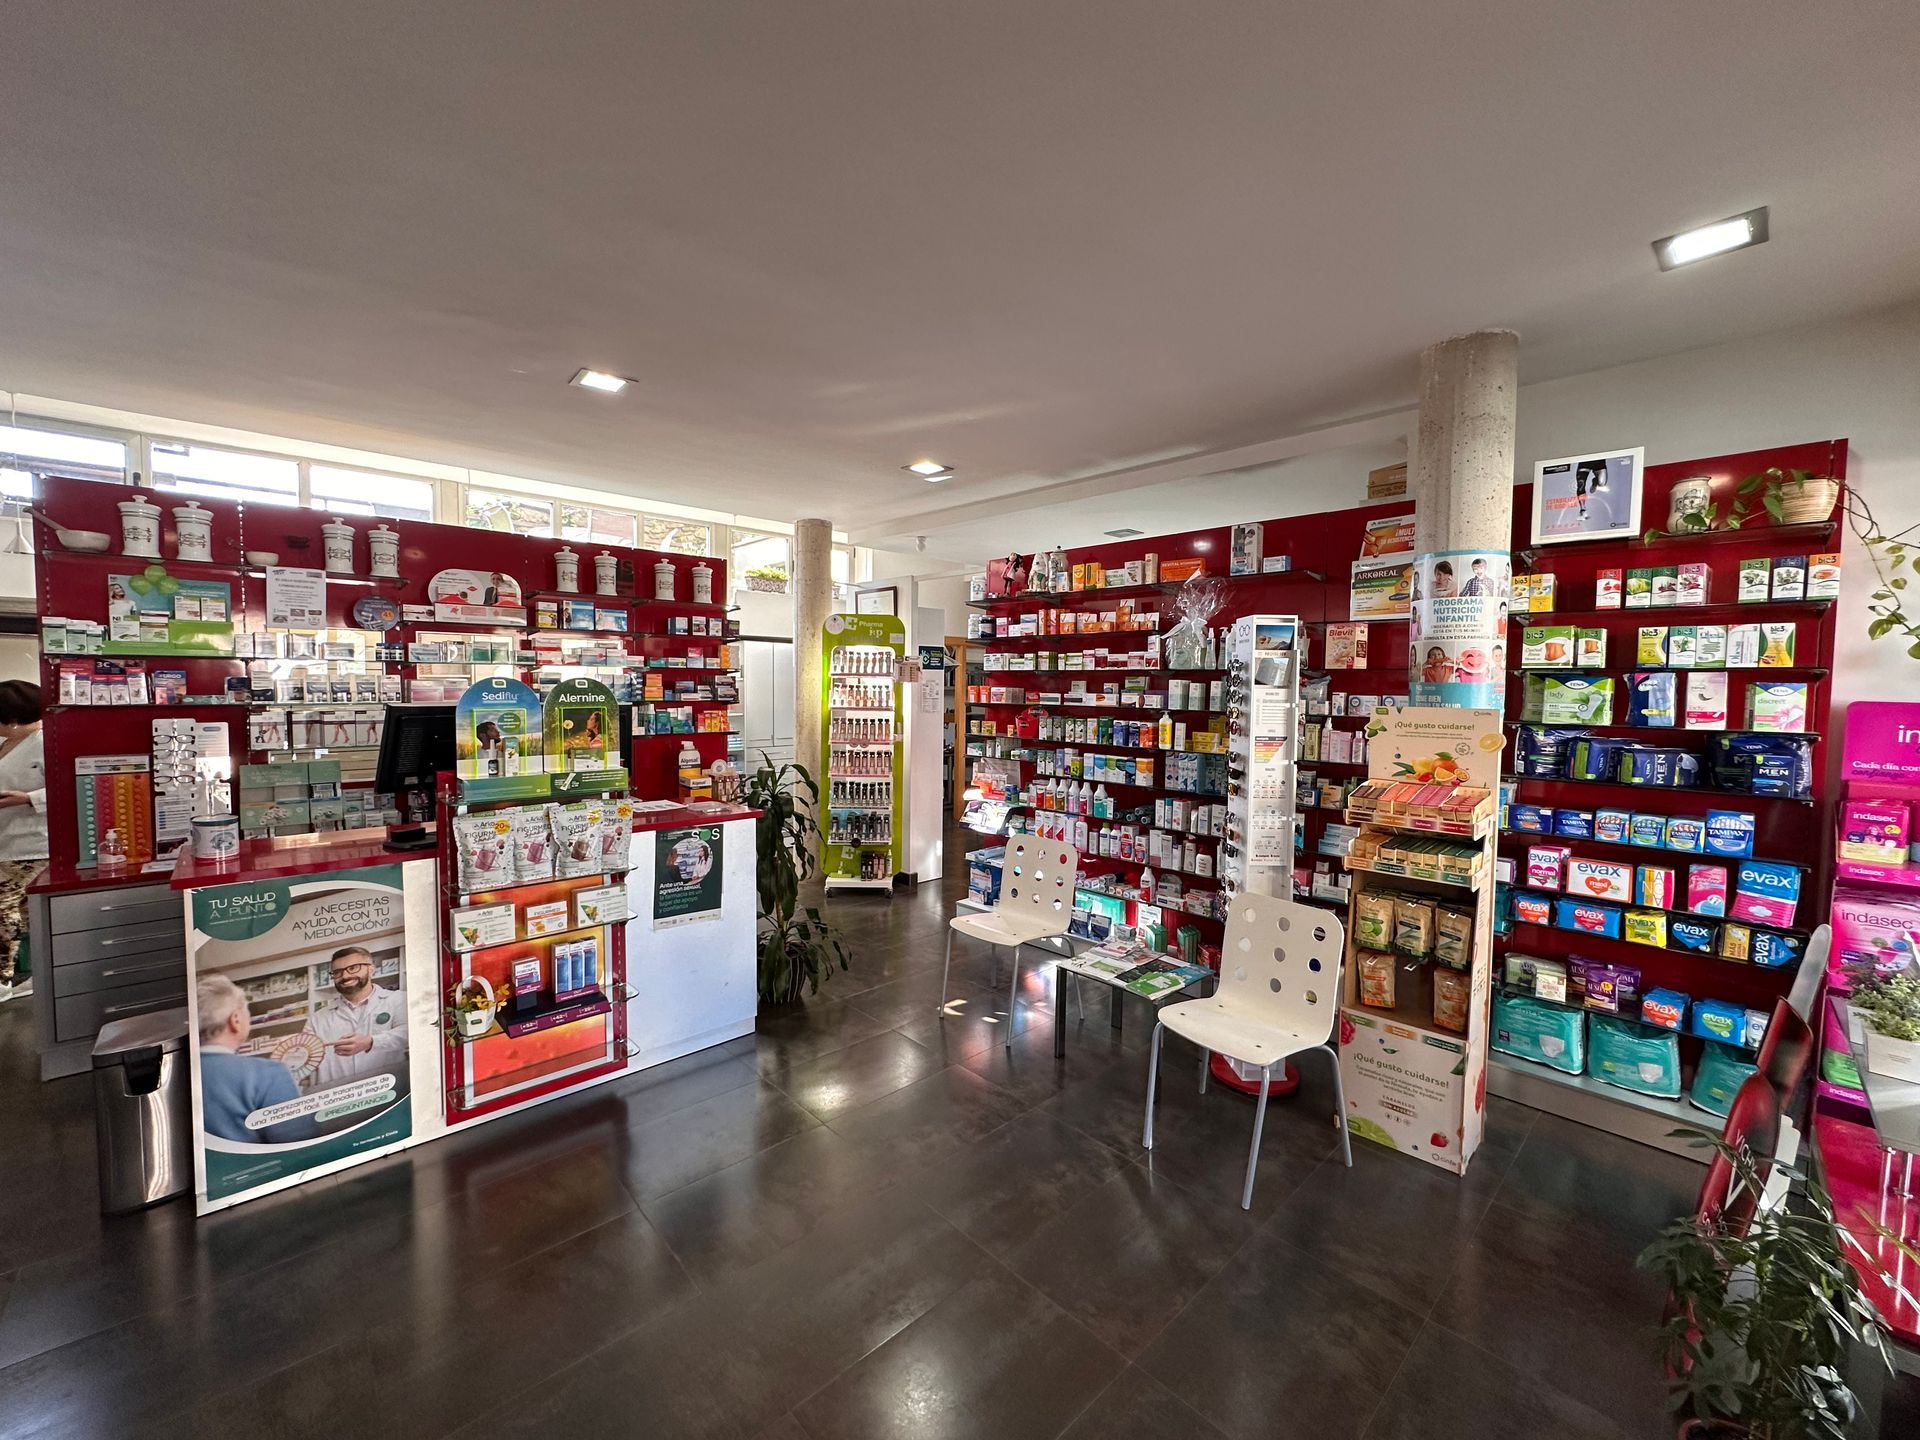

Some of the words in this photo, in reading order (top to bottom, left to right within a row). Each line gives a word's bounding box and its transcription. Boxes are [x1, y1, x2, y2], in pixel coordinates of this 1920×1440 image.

[1357, 570, 1398, 580] ARKOREAL
[1433, 598, 1484, 606] PROGRAMA
[1434, 604, 1482, 614] NUTRICIÓN
[1329, 629, 1354, 637] Blevit
[1526, 630, 1544, 639] bio3
[482, 692, 518, 702] Sediflu
[559, 692, 606, 702] Alernine
[1550, 690, 1564, 700] lady
[1438, 722, 1474, 730] cuidarse!
[1657, 754, 1666, 784] MEN
[1852, 760, 1880, 770] Cada
[1882, 762, 1900, 771] día
[1853, 812, 1897, 823] indasec
[1708, 829, 1744, 837] TAMPAX
[1530, 852, 1560, 864] evax
[1532, 868, 1556, 876] normal
[1578, 862, 1620, 877] evax
[1849, 866, 1885, 877] indasec
[1742, 870, 1792, 890] evax
[209, 898, 228, 910] TU
[232, 892, 276, 906] SALUD
[314, 896, 390, 916] ¿NECESITAS
[1519, 902, 1549, 912] evax
[210, 910, 221, 920] A
[292, 916, 337, 931] AYUDA
[342, 910, 370, 923] CON
[375, 906, 390, 917] TU
[1575, 909, 1604, 920] evax
[1842, 909, 1914, 930] indasec
[1628, 918, 1656, 927] evax
[304, 918, 390, 940] MEDICACIÓN?
[1673, 923, 1708, 936] evax
[1755, 933, 1770, 964] evax
[1643, 1000, 1678, 1016] evax
[1702, 1013, 1732, 1026] evax
[1354, 1052, 1375, 1064] ¡Qué
[1377, 1060, 1402, 1073] gusto
[1405, 1070, 1449, 1088] cuidarse!
[262, 1097, 315, 1117] Organizamos
[333, 1080, 377, 1098] tratamientos
[1829, 1087, 1864, 1102] indasec
[252, 1119, 267, 1127] una
[271, 1109, 301, 1120] manera
[324, 1093, 354, 1105] cómoda
[365, 1083, 390, 1094] segura
